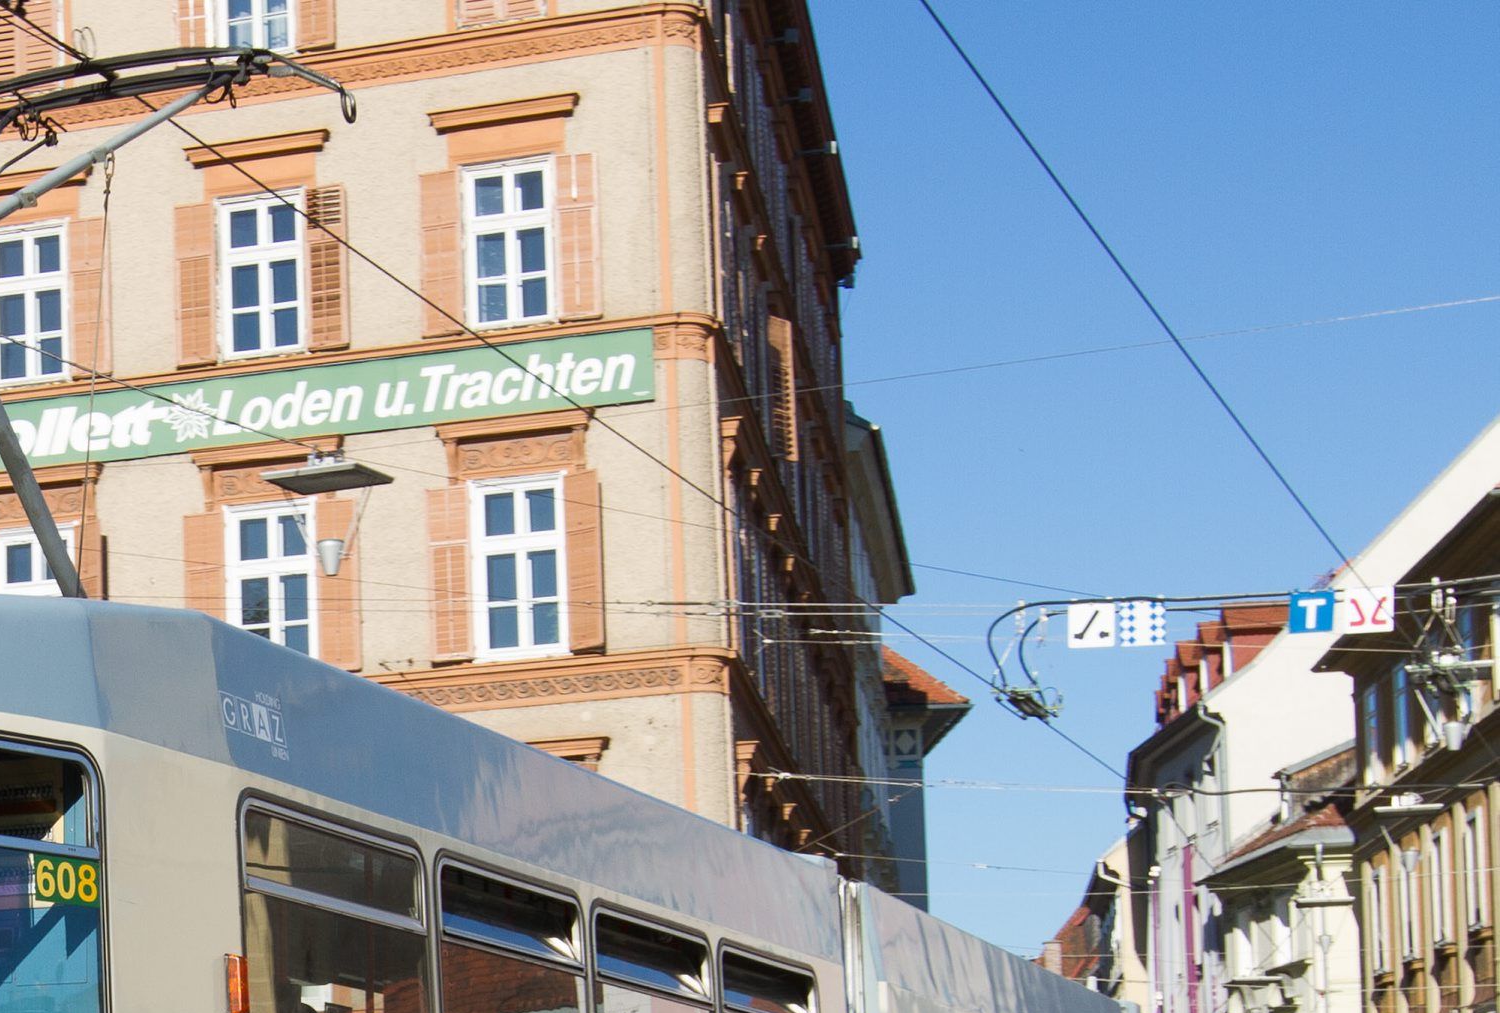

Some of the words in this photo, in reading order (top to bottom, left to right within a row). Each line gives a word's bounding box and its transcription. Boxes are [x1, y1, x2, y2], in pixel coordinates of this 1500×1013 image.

[212, 380, 364, 437] Loden
[222, 697, 285, 743] GRAZ
[36, 859, 98, 903] 608
